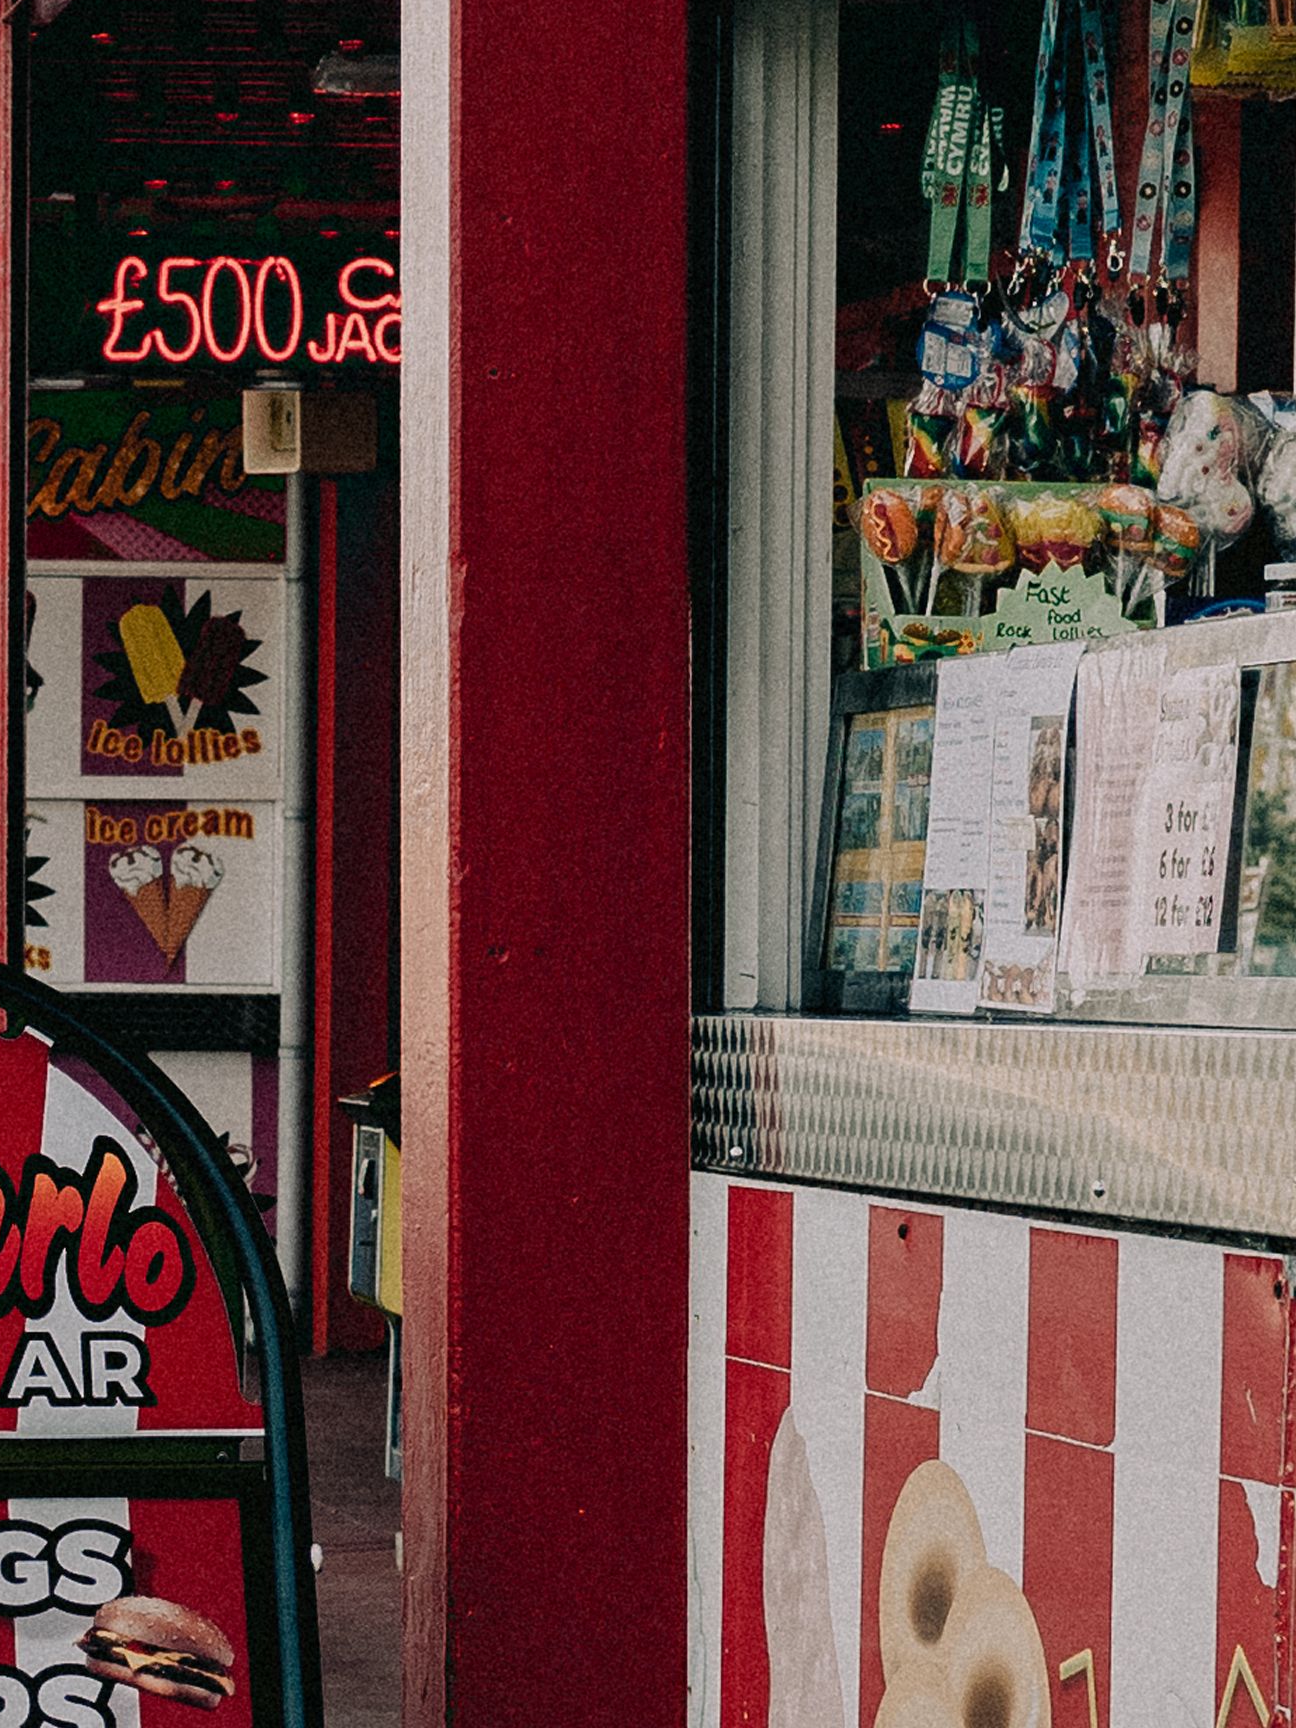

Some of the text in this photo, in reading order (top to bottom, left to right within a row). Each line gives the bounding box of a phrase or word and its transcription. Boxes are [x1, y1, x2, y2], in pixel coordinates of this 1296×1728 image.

[945, 84, 974, 176] CYMRU
[95, 256, 304, 364] £500
[1024, 580, 1071, 607] Fast
[995, 622, 1033, 639] Rock
[1047, 608, 1083, 625] food
[151, 724, 264, 769] lollies
[143, 805, 256, 845] cream
[1163, 802, 1174, 834] 3
[1177, 801, 1199, 833] for
[1159, 849, 1168, 880] 6
[1171, 847, 1191, 880] for
[1154, 896, 1168, 928] 12
